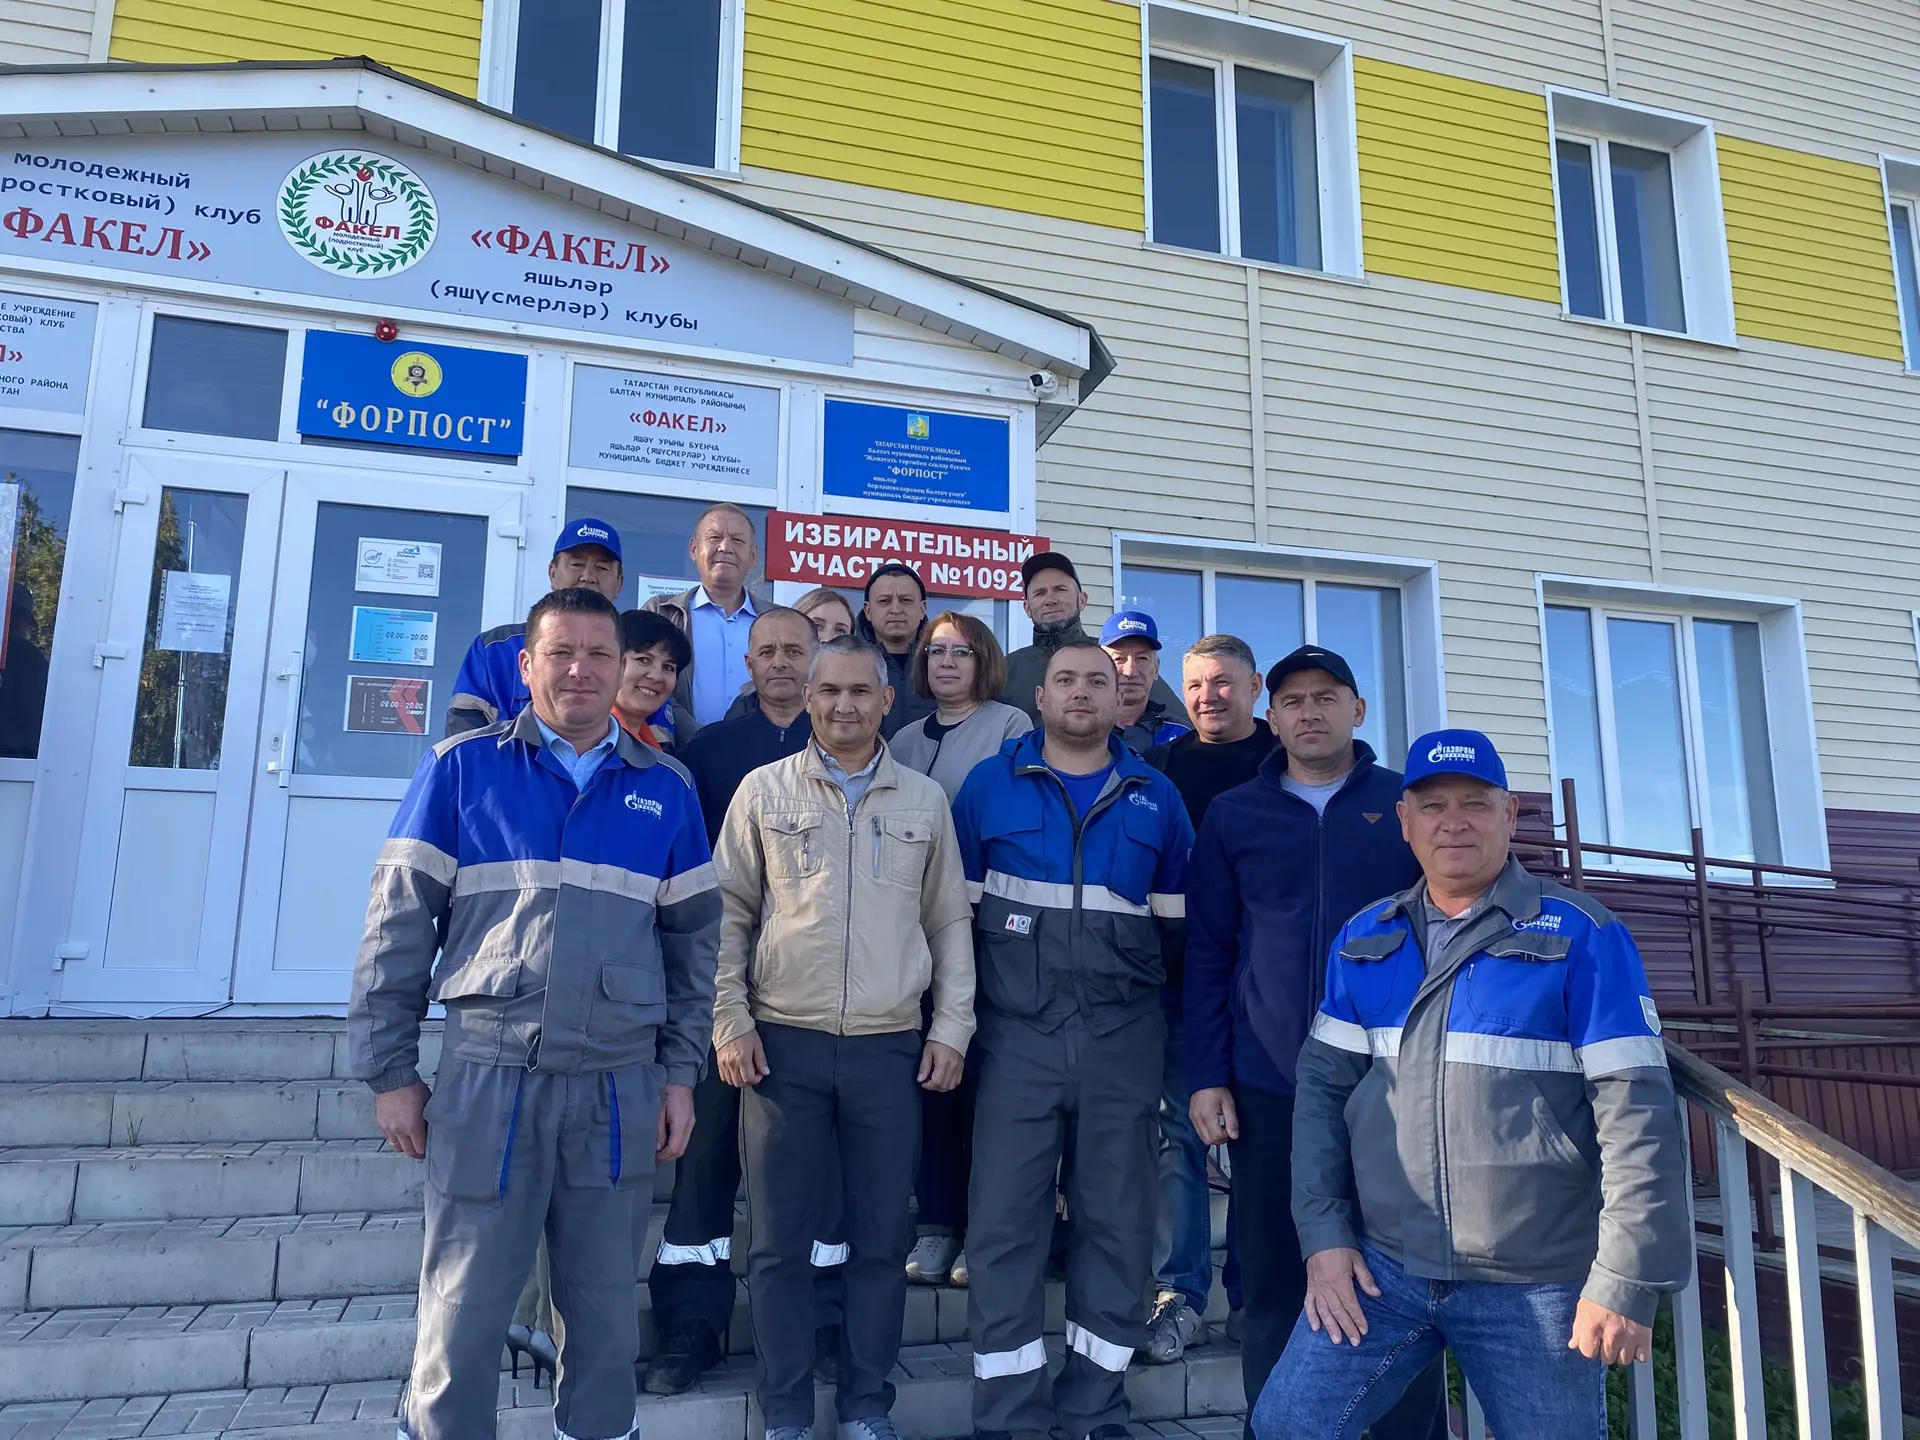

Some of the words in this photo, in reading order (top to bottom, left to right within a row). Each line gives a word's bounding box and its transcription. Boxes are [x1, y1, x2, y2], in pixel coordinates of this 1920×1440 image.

[13, 152, 191, 189] молодежный
[194, 204, 262, 225] клуб
[3, 206, 211, 262] ФАКЕЛ»
[315, 216, 400, 240] ФАКЕЛ
[470, 224, 671, 275] «ФАКЕЛ»
[523, 271, 613, 297] яшьләр
[13, 304, 76, 319] УЧРЕЖДЕНИЕ
[430, 279, 609, 321] (яшүсмерләр)
[40, 318, 65, 329] КЛУБ
[625, 309, 698, 331] клубы
[30, 378, 69, 390] РАЙОНА
[610, 387, 641, 397] БАЛТАЧ
[645, 391, 697, 404] МУНИЦИПАЛЬ
[623, 378, 670, 391] ТАТАРСТАН
[673, 385, 734, 399] РЕСПУБЛИКАСЫ
[629, 409, 727, 434] «ФАКЕЛ»
[658, 438, 685, 448] УРЫНЫ
[689, 441, 720, 452] БУЕНЧА
[874, 440, 910, 450] ТАТАРСТАН
[910, 444, 961, 455] РЕСПУБЛИКАСЫ
[598, 451, 650, 464] МУНИЦИПАЛЬ
[655, 457, 686, 468] БЮДЖЕТ
[690, 462, 751, 475] УЧРЕЖДЕНИЕСЕ
[785, 520, 1034, 563] ИЗБИРАТЕЛЬНЫЙ
[789, 550, 922, 578] УЧАСТК
[930, 562, 1023, 592] №1092
